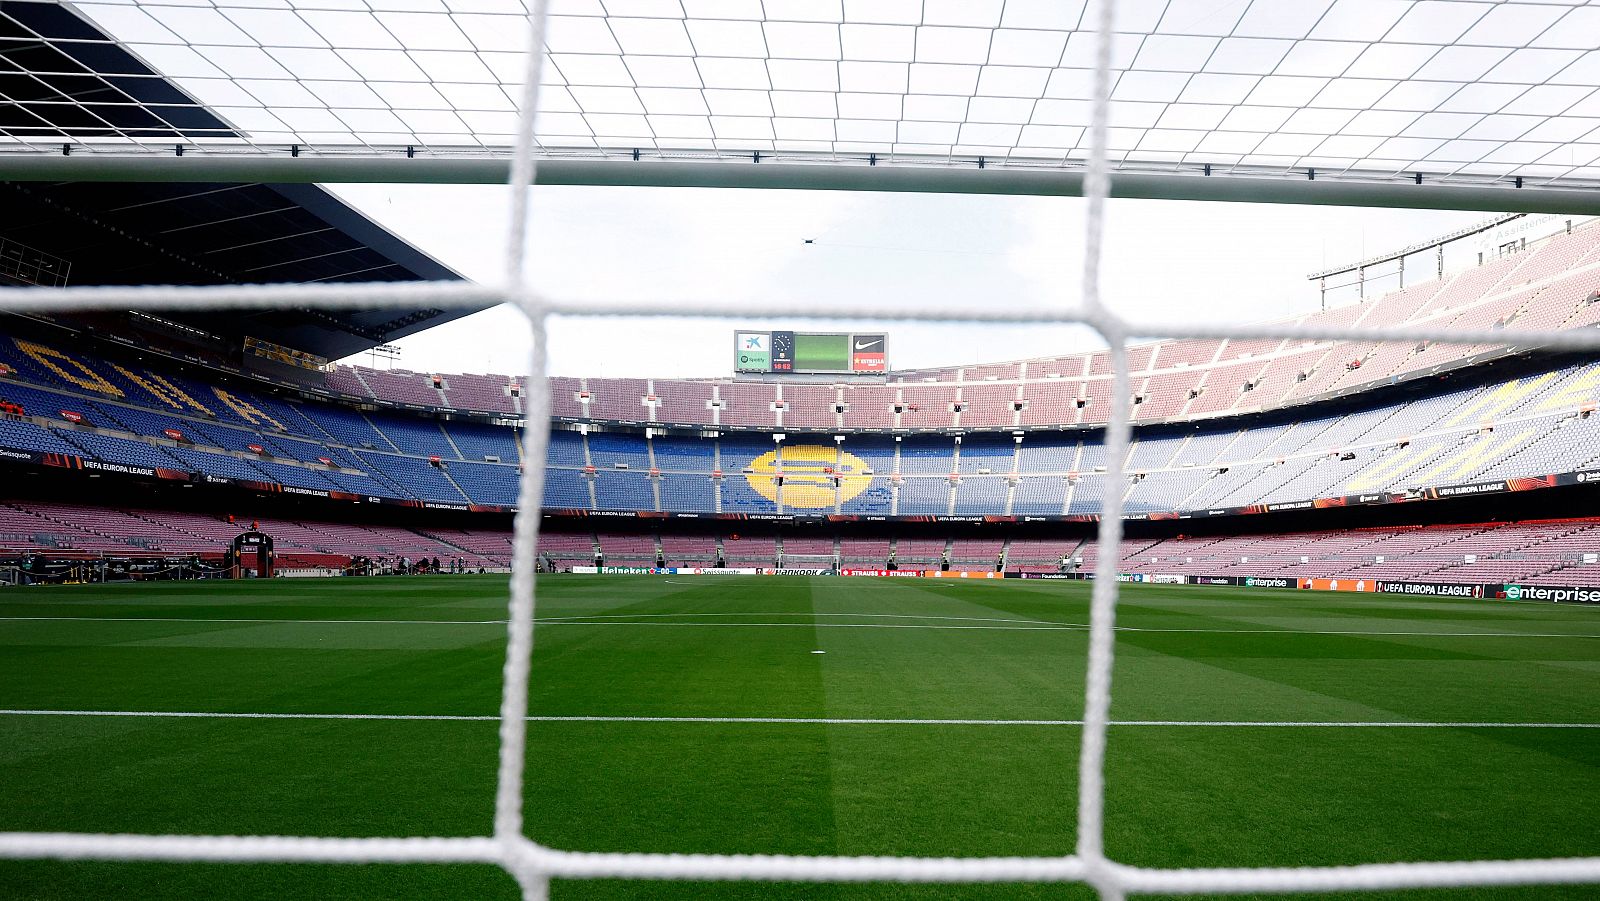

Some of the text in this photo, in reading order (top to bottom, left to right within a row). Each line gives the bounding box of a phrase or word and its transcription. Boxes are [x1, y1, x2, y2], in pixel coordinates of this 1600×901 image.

[0, 450, 31, 459] Swissquote
[84, 461, 154, 476] UEFA EUROPA LEAGUE
[1455, 485, 1478, 494] EUROPA
[1478, 483, 1504, 492] LEAGUE
[602, 566, 647, 574] Heineken
[1246, 577, 1287, 588] enterprise
[1384, 583, 1472, 596] UEFA EUROPA LEAGUE
[1503, 586, 1600, 603] enterprise
